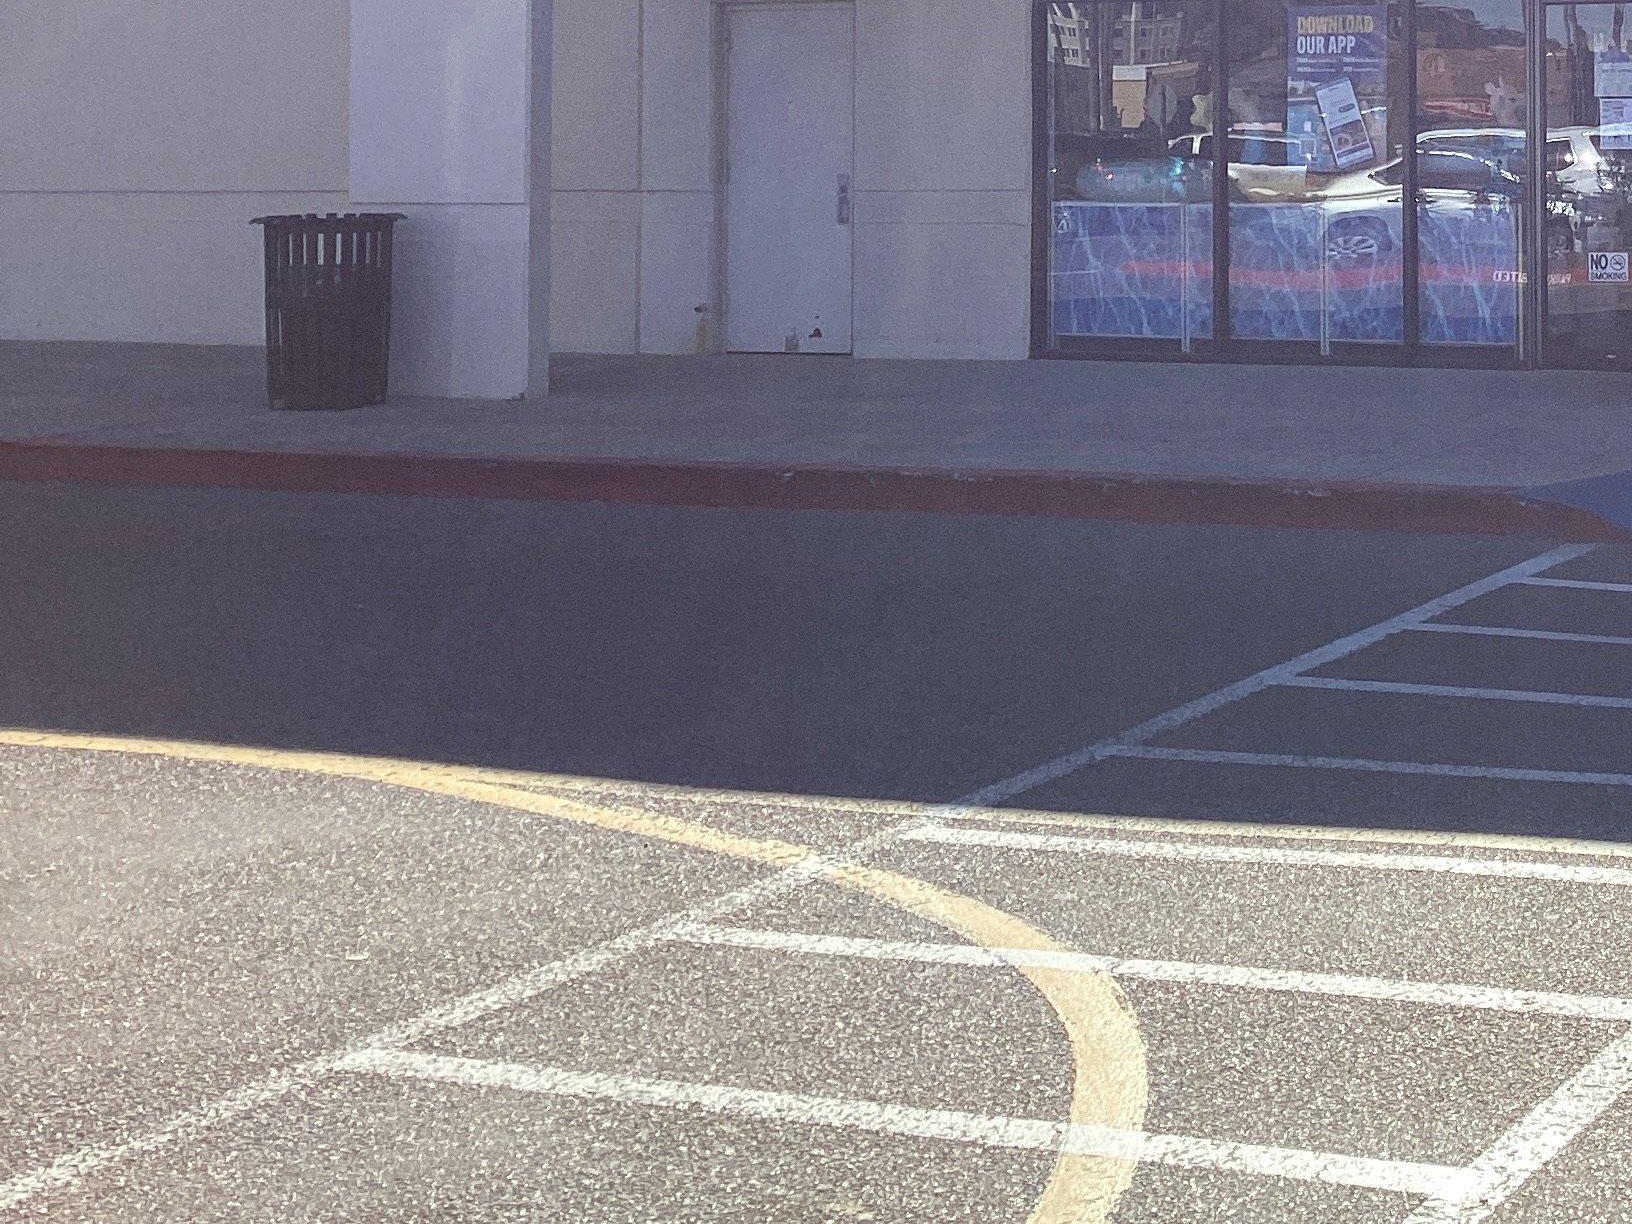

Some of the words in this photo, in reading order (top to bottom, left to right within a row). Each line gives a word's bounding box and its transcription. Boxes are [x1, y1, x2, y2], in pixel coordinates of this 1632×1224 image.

[1297, 15, 1374, 34] DOWNLOAD
[1297, 35, 1325, 54] OUR
[1328, 35, 1356, 54] APP
[1591, 254, 1608, 270] NO
[1590, 272, 1627, 281] SMOKING
